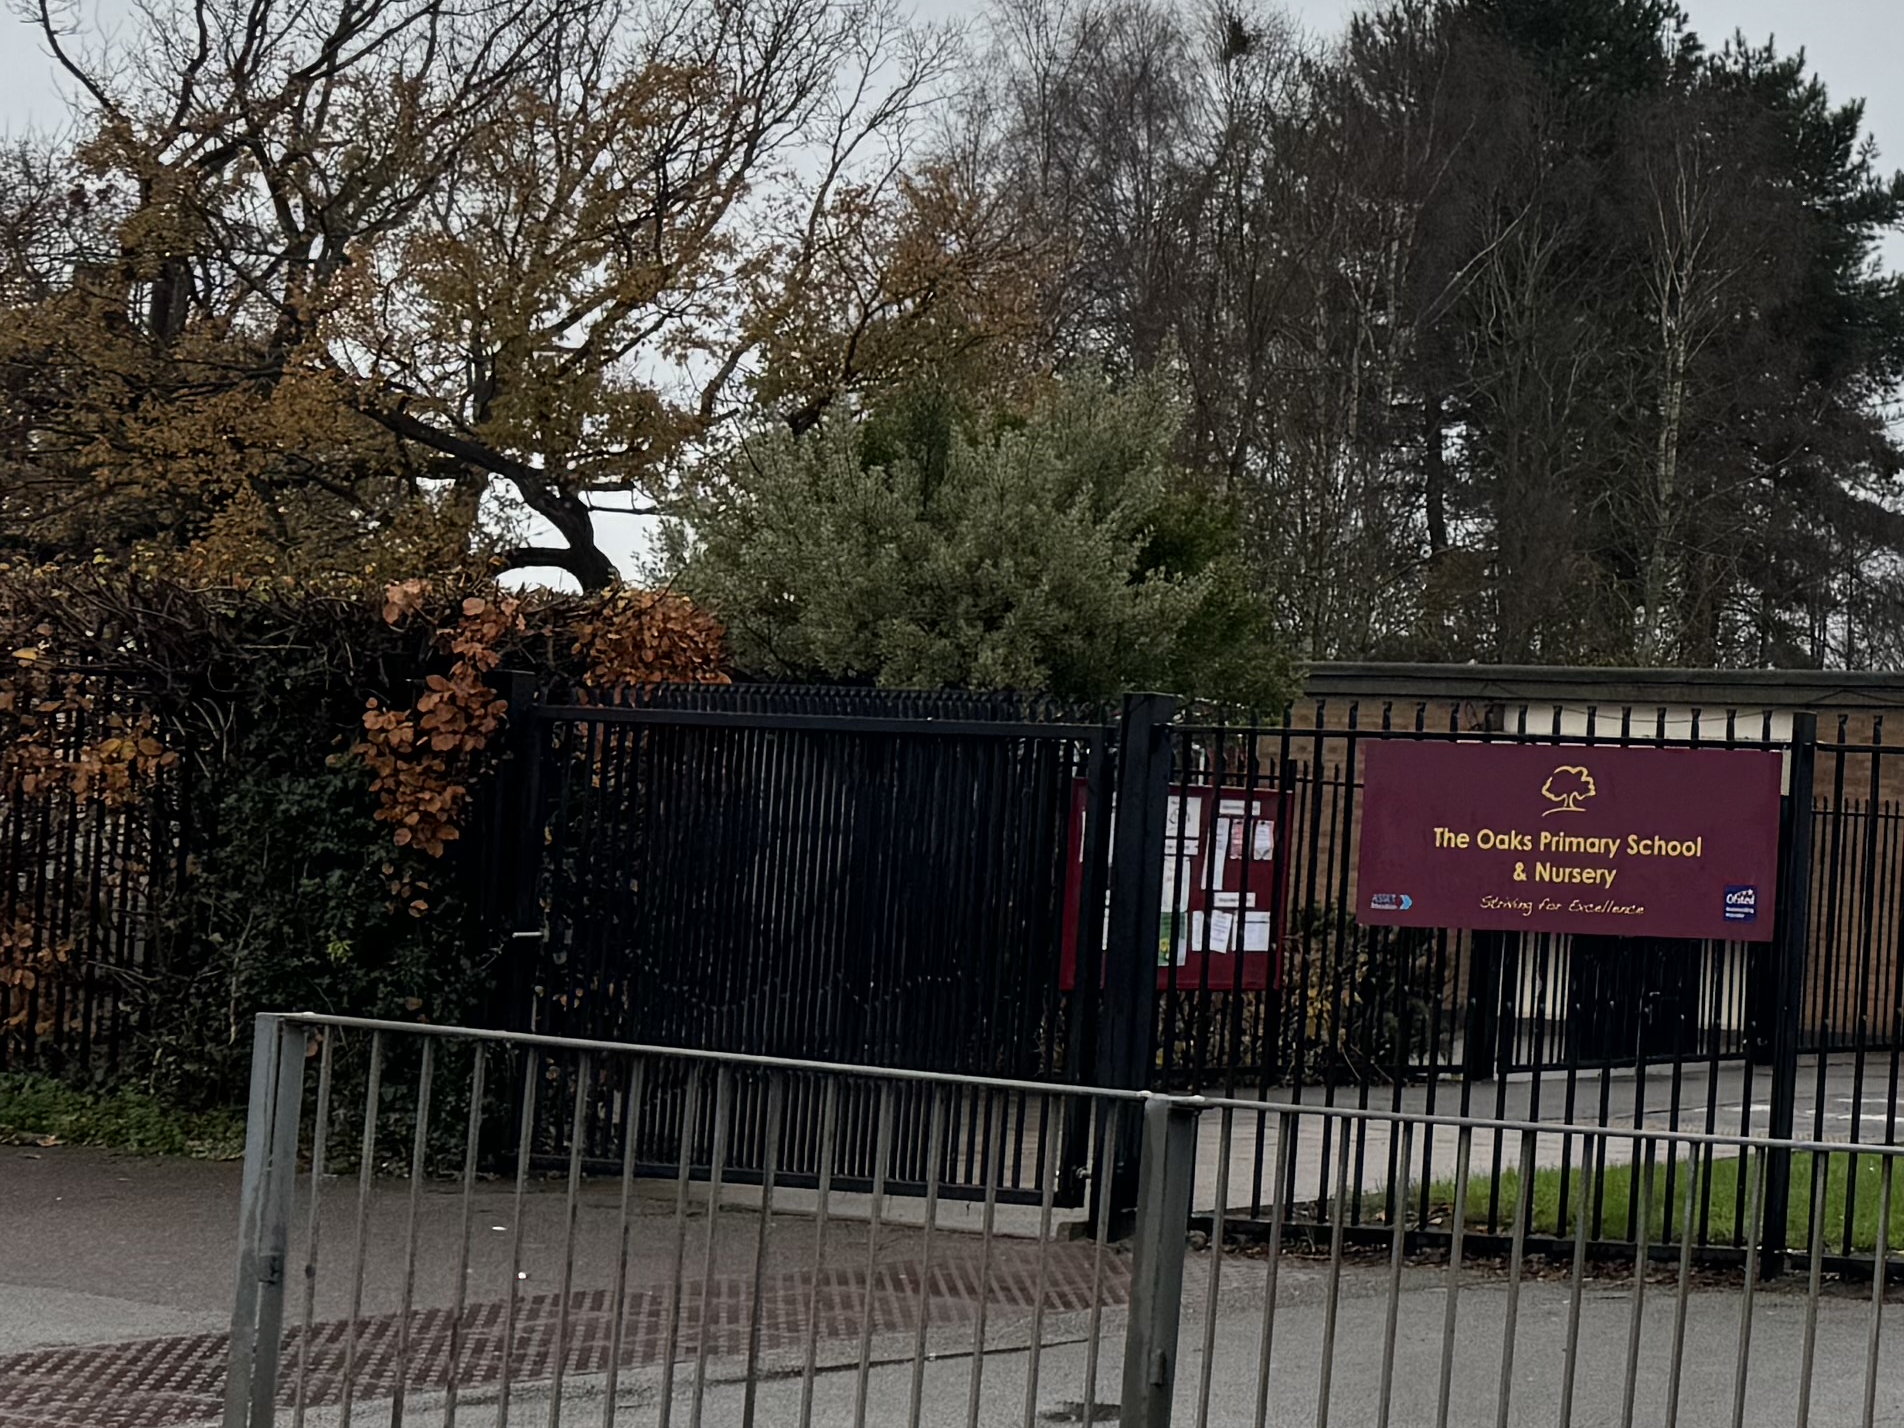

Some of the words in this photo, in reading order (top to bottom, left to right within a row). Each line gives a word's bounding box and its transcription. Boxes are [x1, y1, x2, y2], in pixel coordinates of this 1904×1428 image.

[1434, 827, 1470, 849] The
[1477, 828, 1532, 851] Oaks
[1540, 831, 1621, 859] Primary
[1626, 834, 1702, 857] School
[1513, 861, 1527, 882] &
[1535, 861, 1617, 889] Nursery
[1480, 895, 1533, 916] Striving
[1538, 897, 1562, 911] for
[1568, 899, 1645, 915] Excellence
